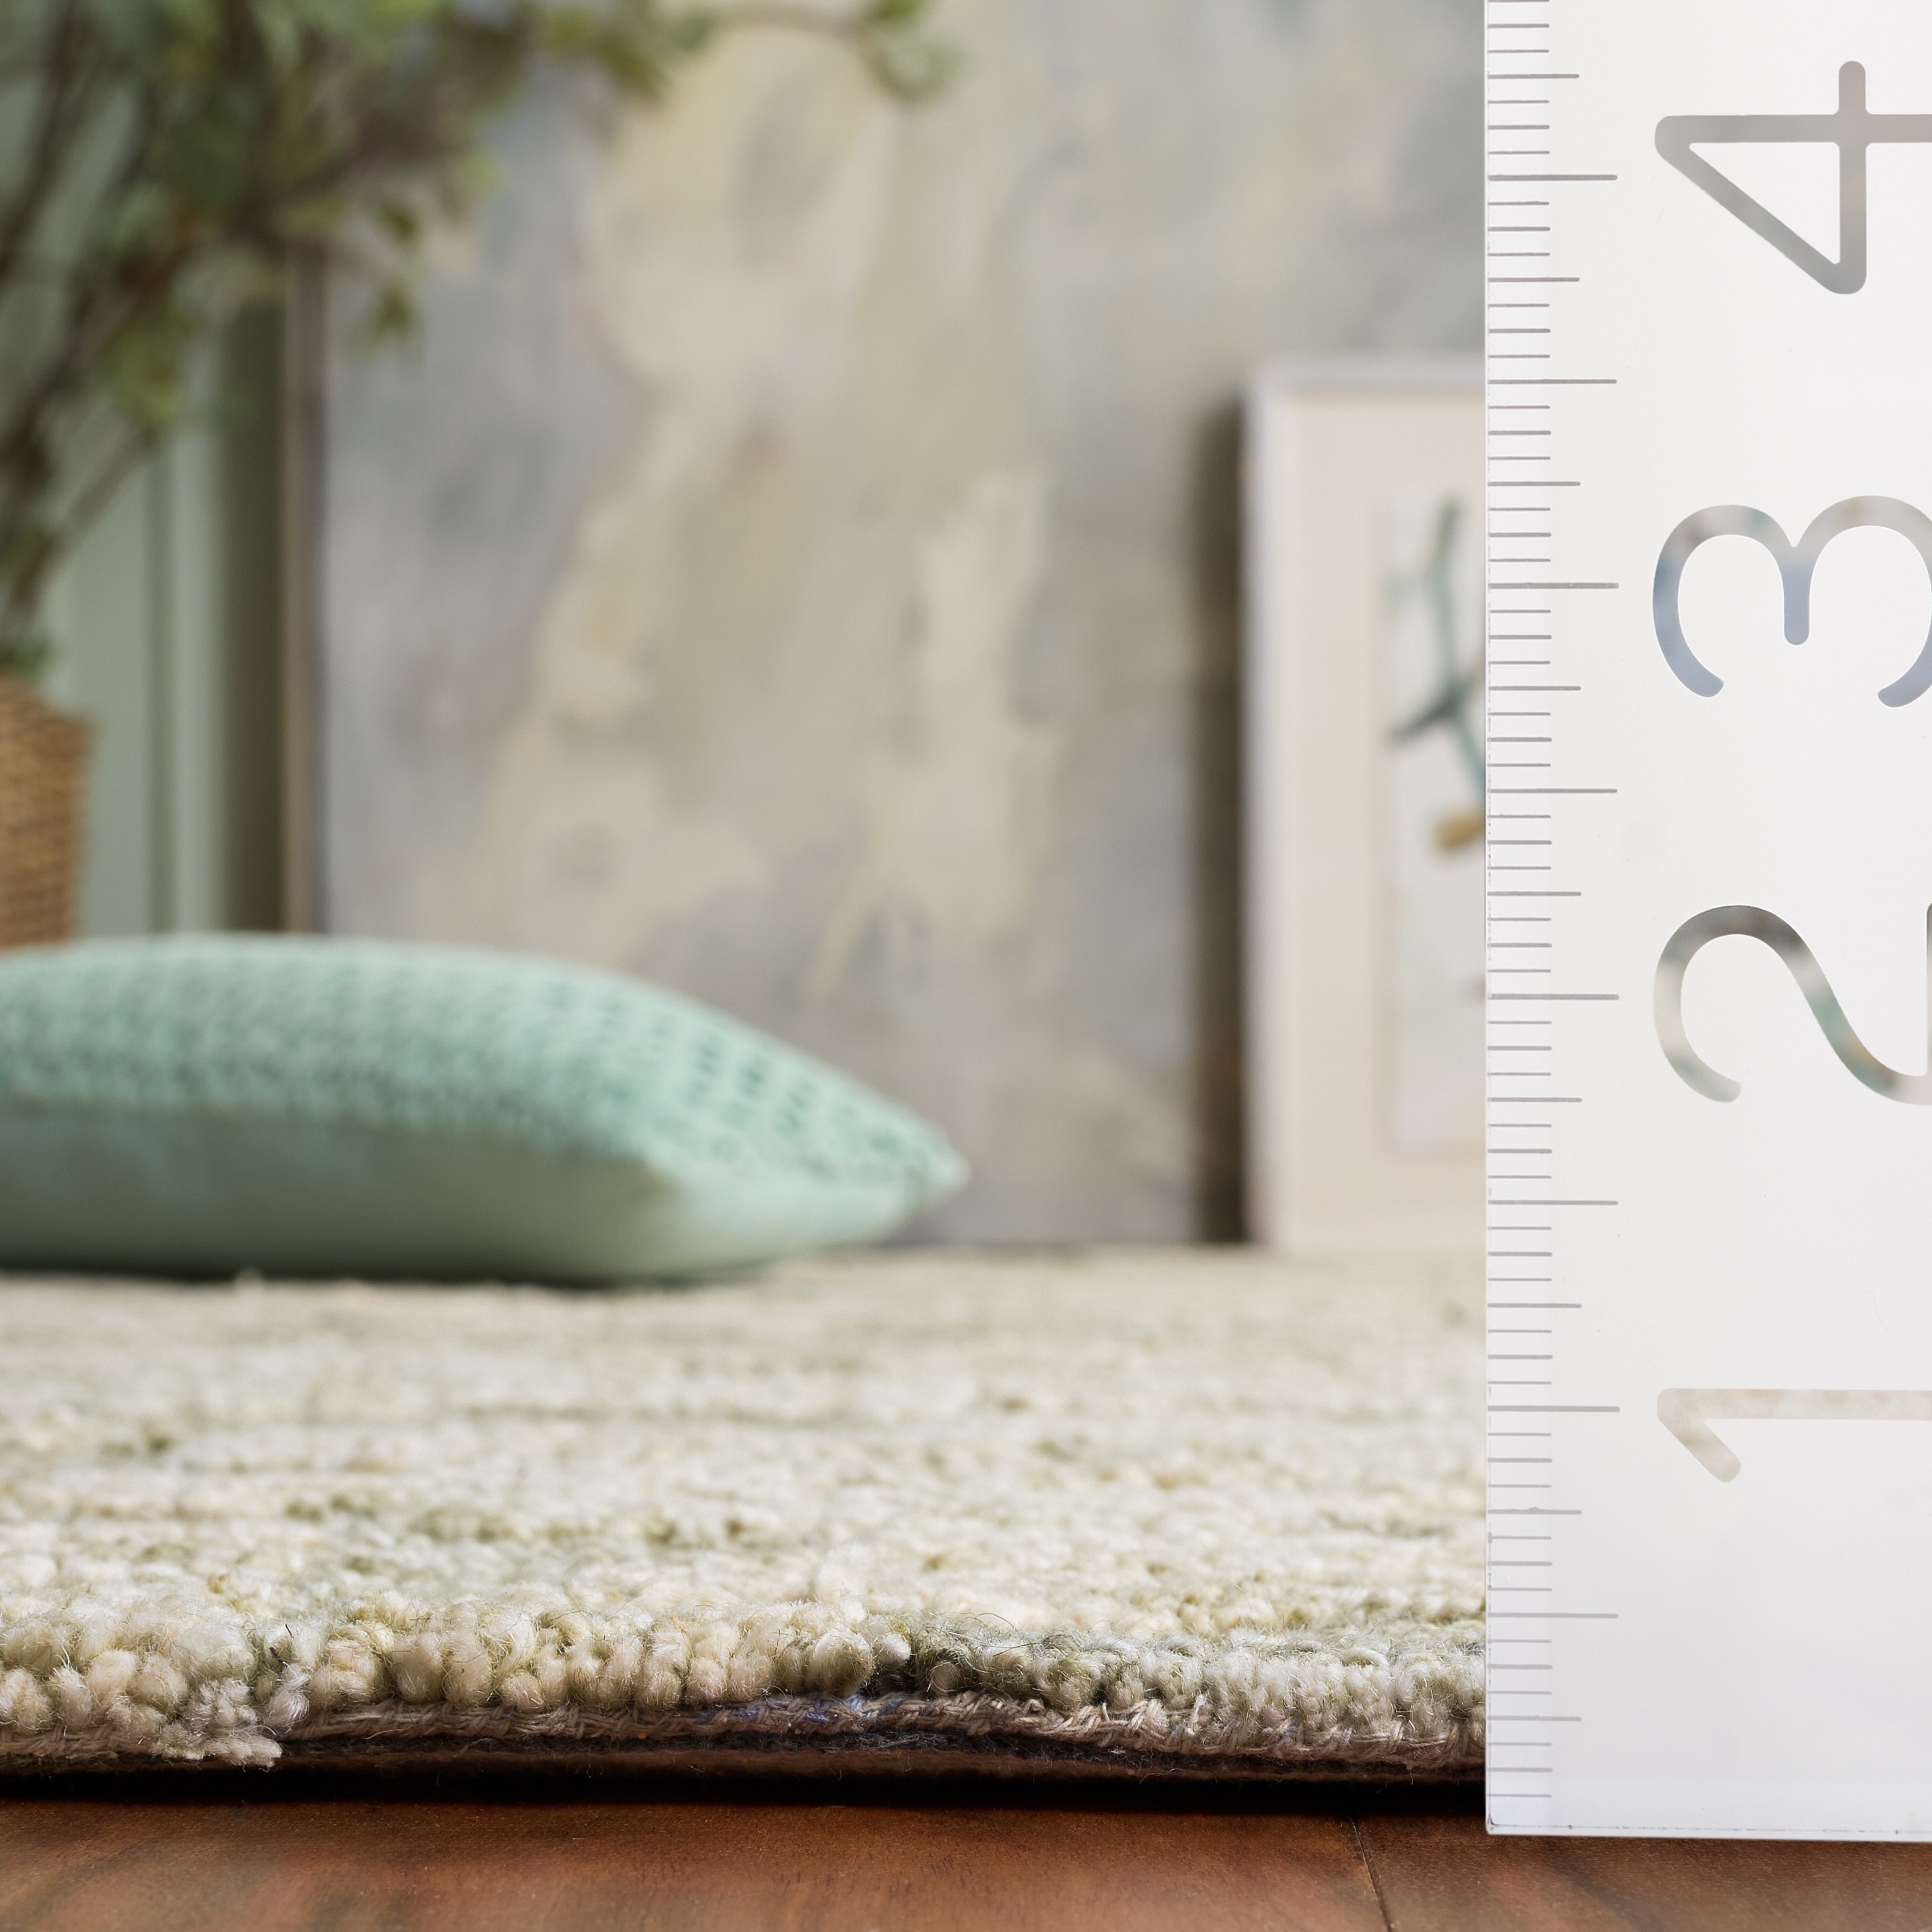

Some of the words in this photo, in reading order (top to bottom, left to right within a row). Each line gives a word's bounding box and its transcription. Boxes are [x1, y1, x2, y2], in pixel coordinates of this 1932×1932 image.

[1655, 60, 1932, 294] 4
[1652, 495, 1932, 708] 3
[1653, 905, 1932, 1106] 2
[1657, 1388, 1932, 1482] 1
